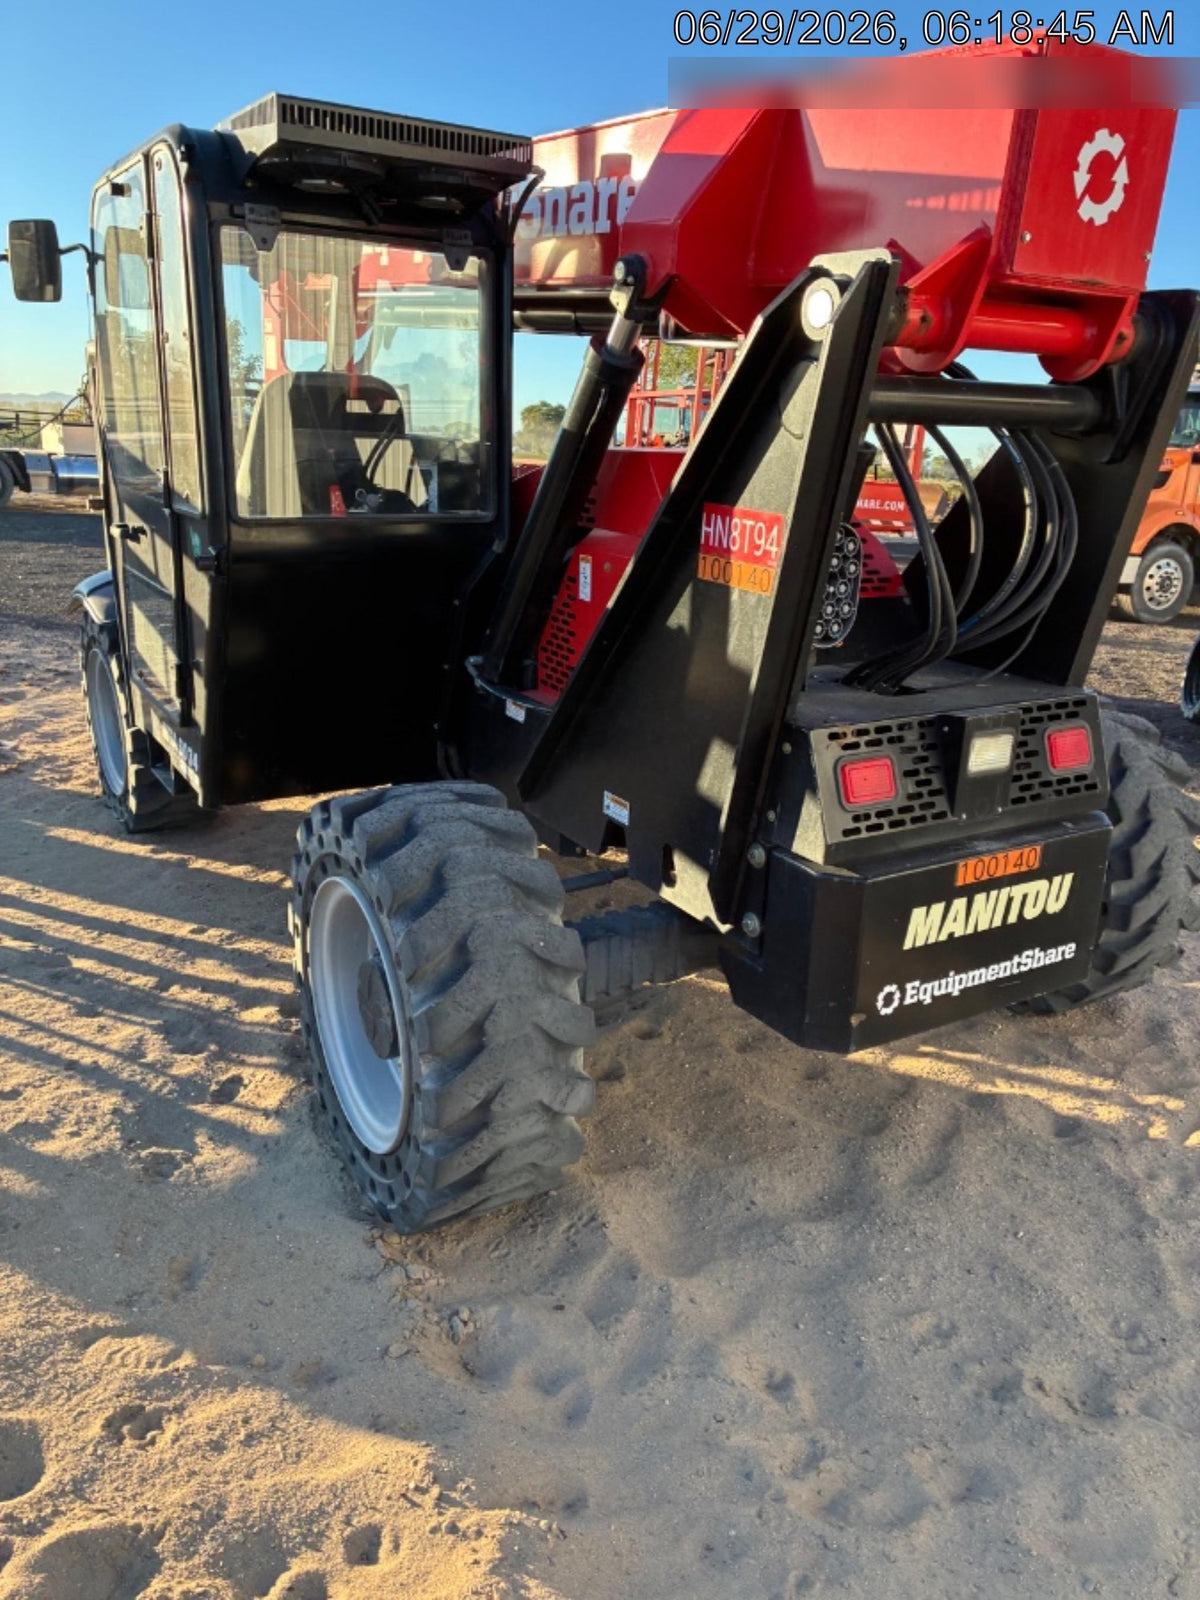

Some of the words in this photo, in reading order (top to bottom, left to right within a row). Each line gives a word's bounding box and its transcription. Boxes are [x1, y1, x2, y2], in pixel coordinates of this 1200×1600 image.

[700, 511, 779, 559] HN8T94
[701, 555, 772, 593] 100140
[961, 847, 1039, 883] 100140
[902, 872, 1075, 950] MANITOU
[903, 942, 1077, 1005] EquipmentShare
